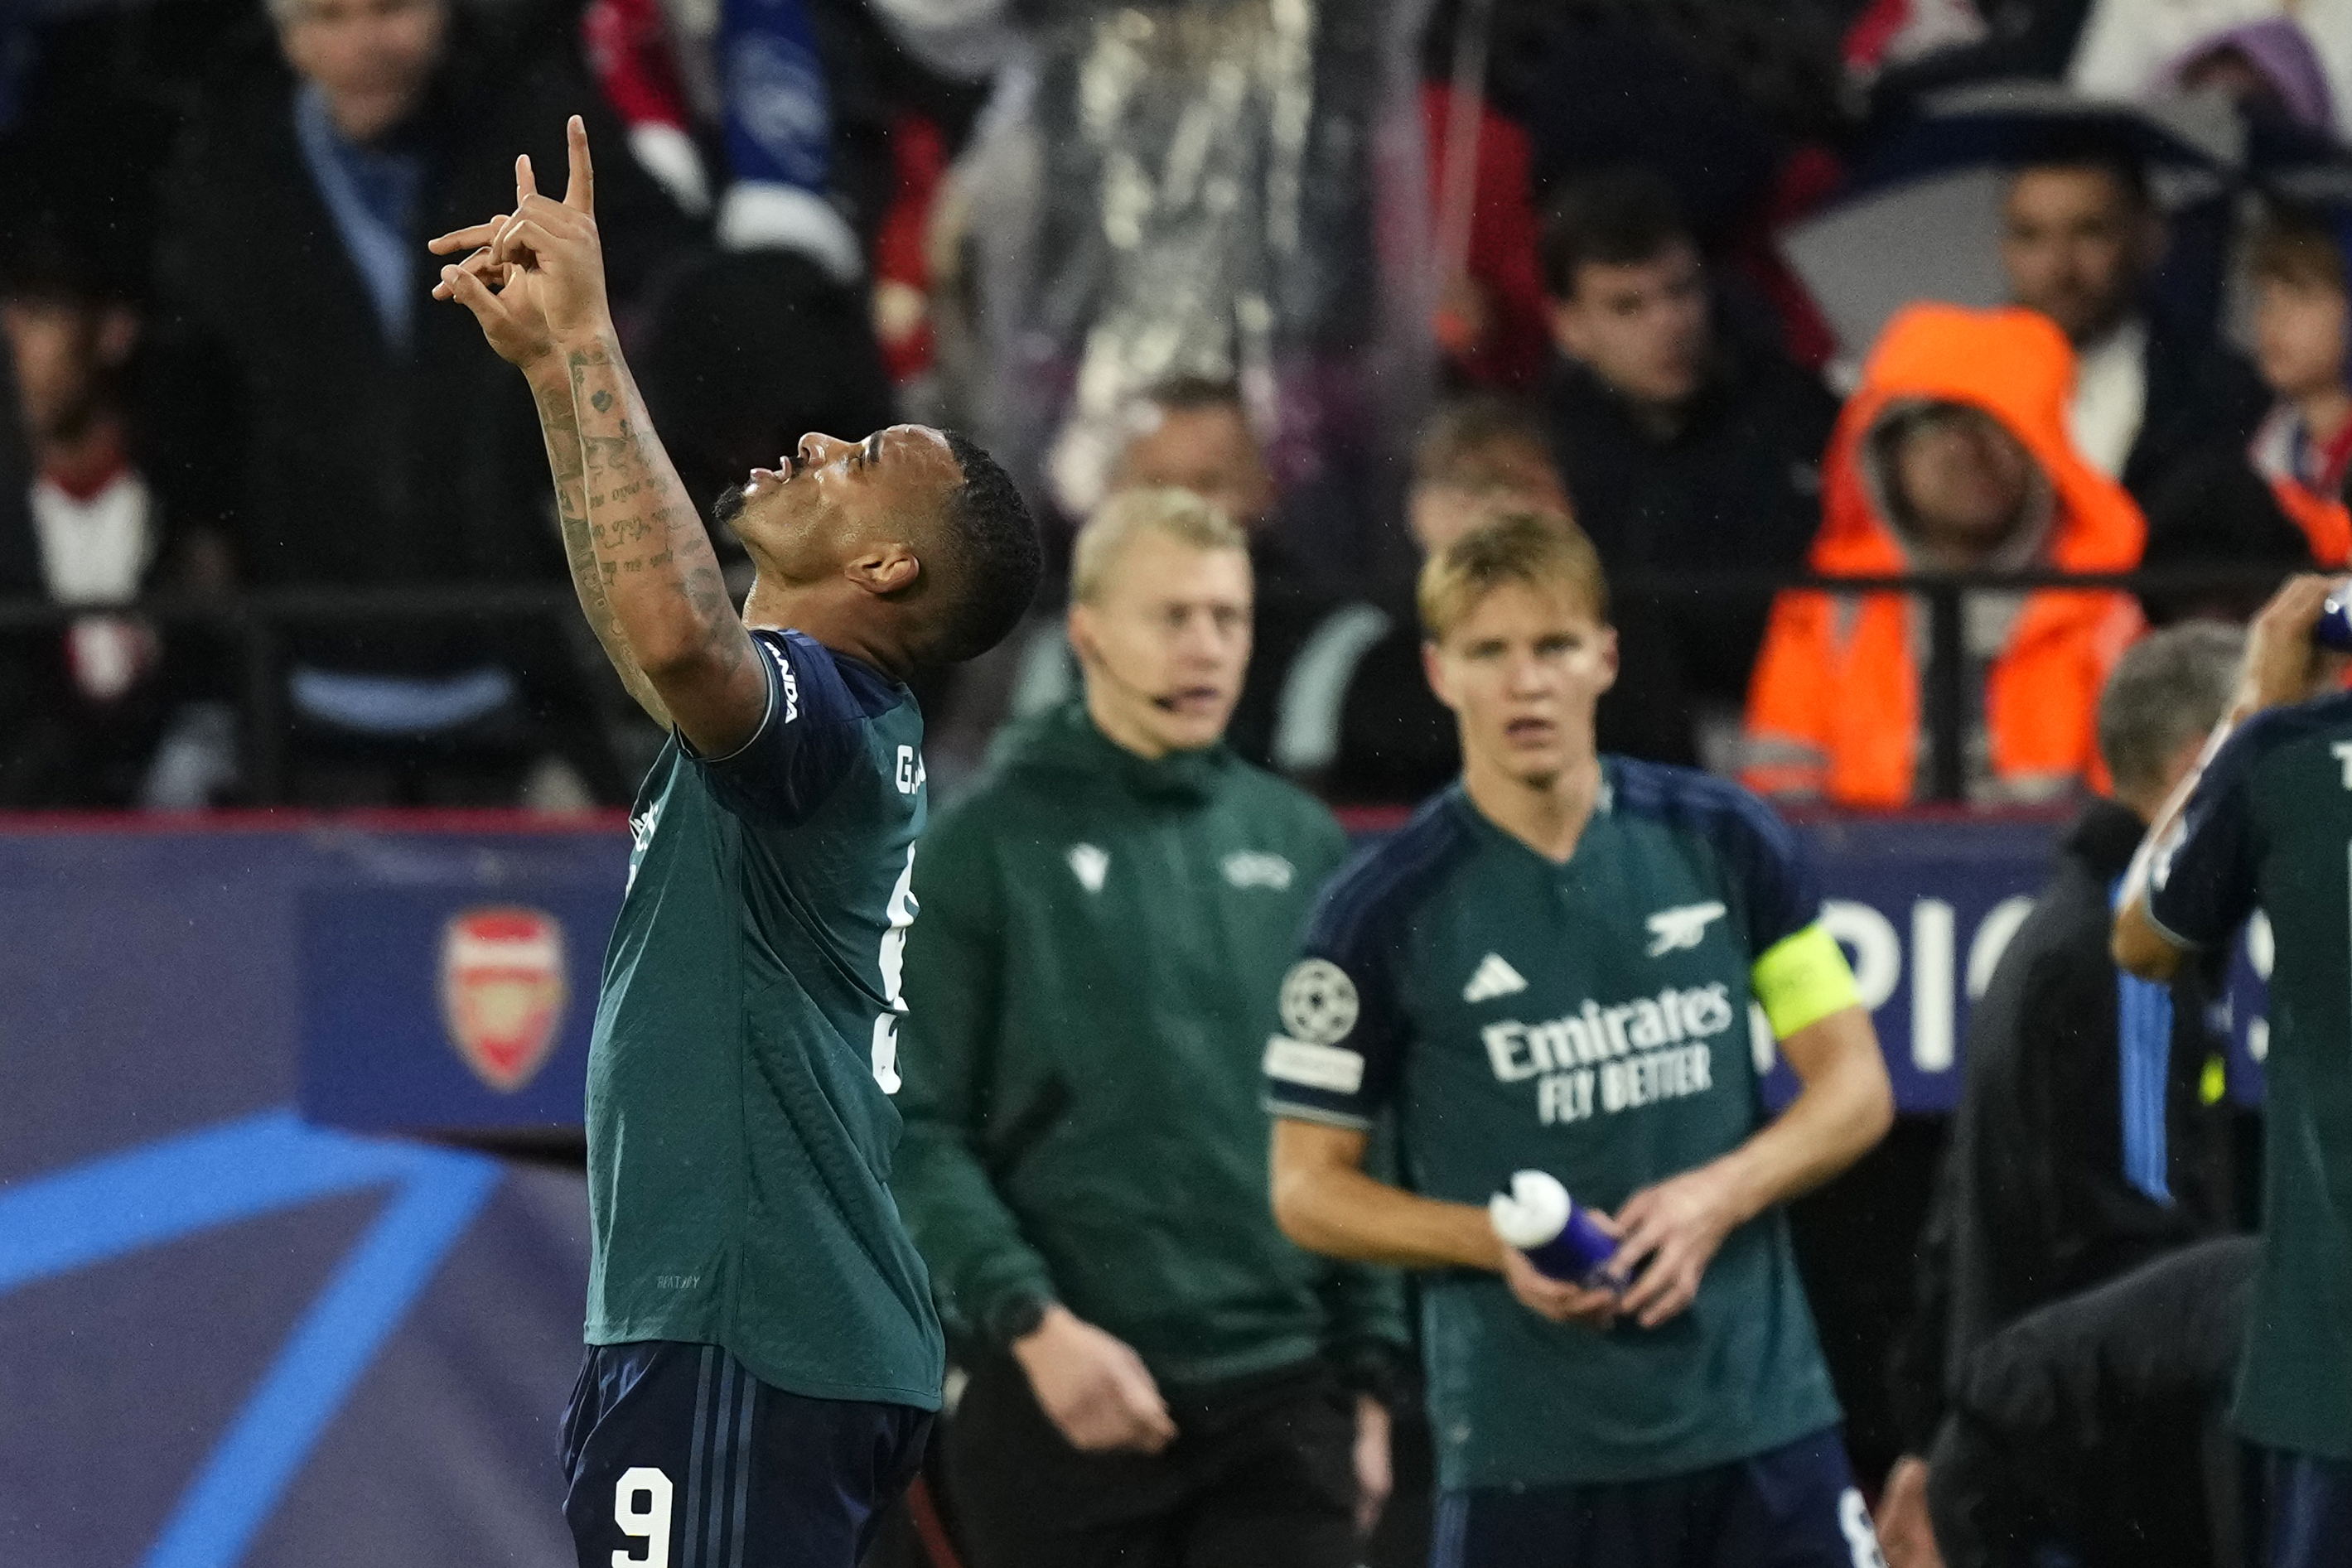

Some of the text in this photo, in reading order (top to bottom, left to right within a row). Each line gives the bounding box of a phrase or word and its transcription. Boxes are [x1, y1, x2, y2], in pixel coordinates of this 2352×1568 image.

[764, 642, 799, 724] ANDA
[1481, 982, 1733, 1082] Emirates
[1538, 1042, 1712, 1126] FLY BETTER
[611, 1467, 673, 1568] 9
